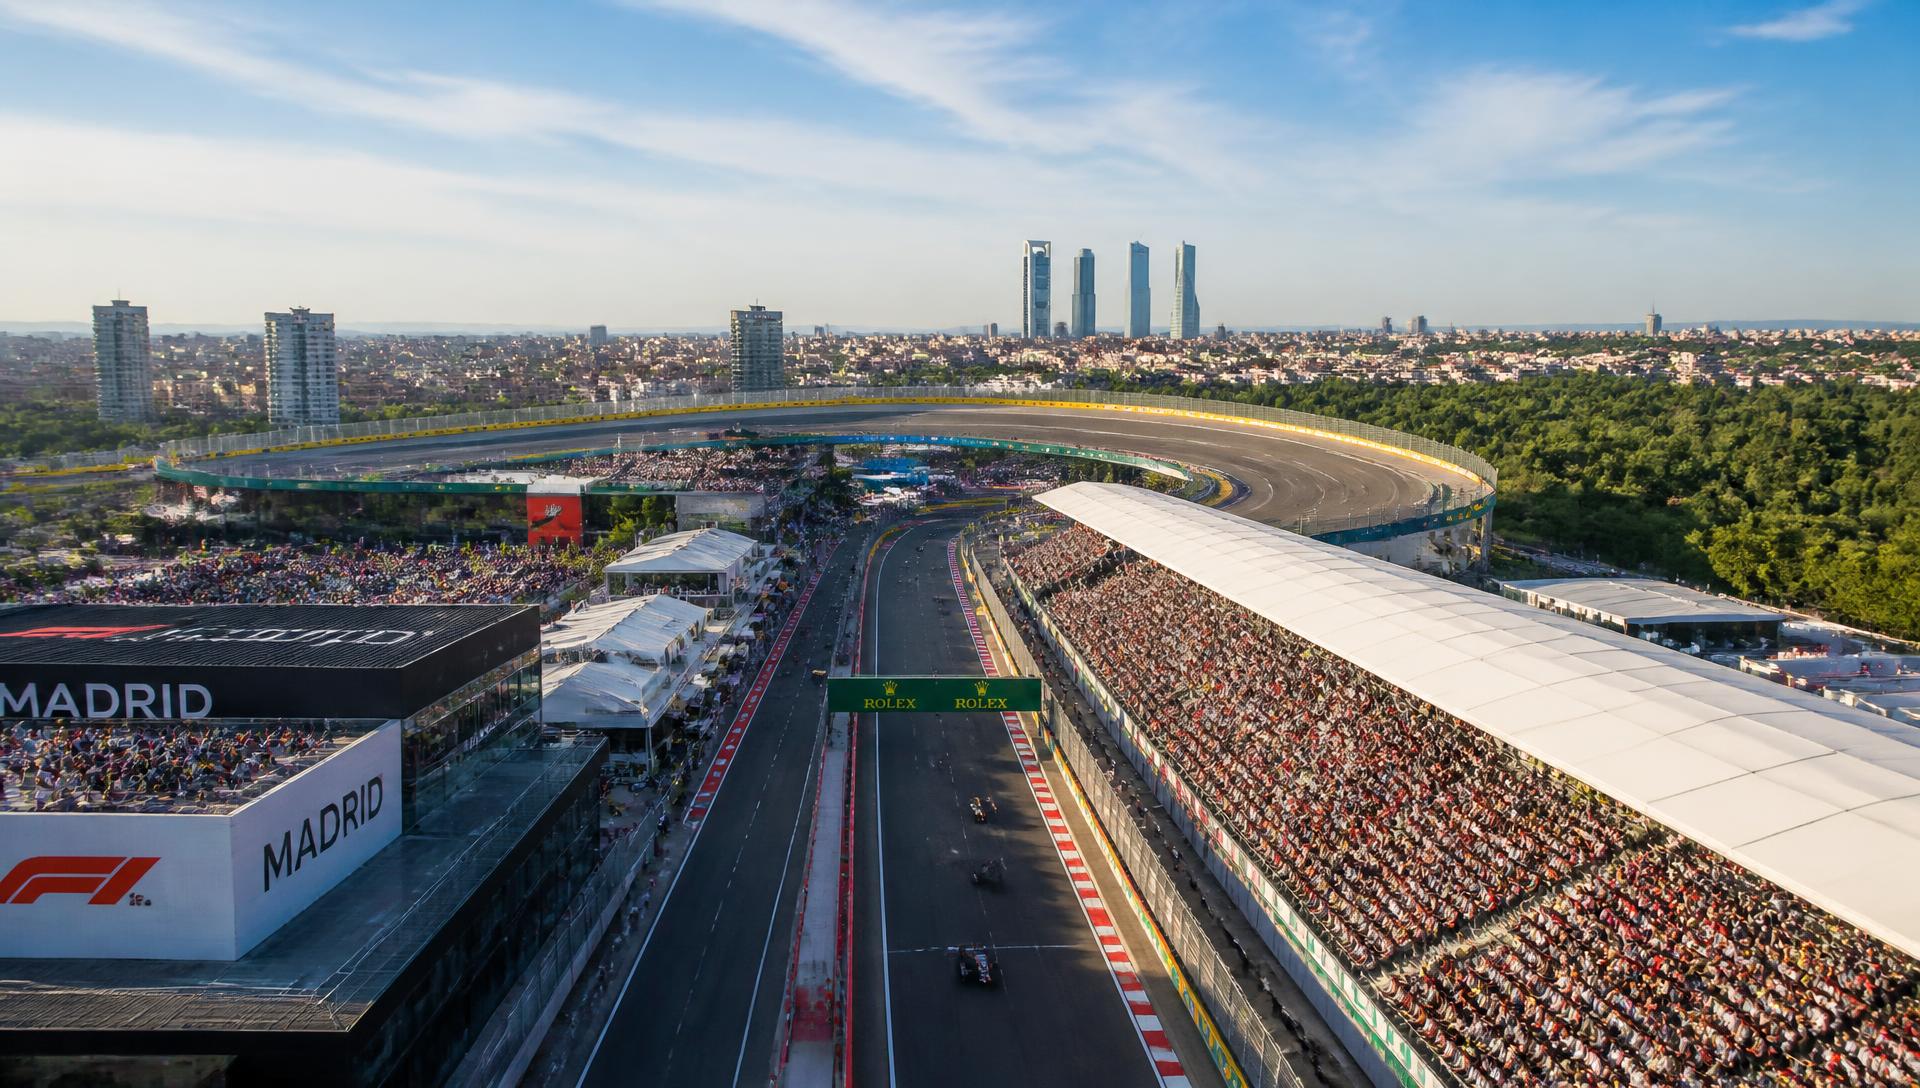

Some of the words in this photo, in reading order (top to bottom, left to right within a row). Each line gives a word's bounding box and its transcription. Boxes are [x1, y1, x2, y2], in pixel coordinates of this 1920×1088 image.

[0, 683, 212, 718] MADRID
[864, 698, 916, 709] ROLEX
[955, 698, 1007, 709] ROLEX
[264, 776, 383, 892] MADRID
[0, 856, 161, 905] F1
